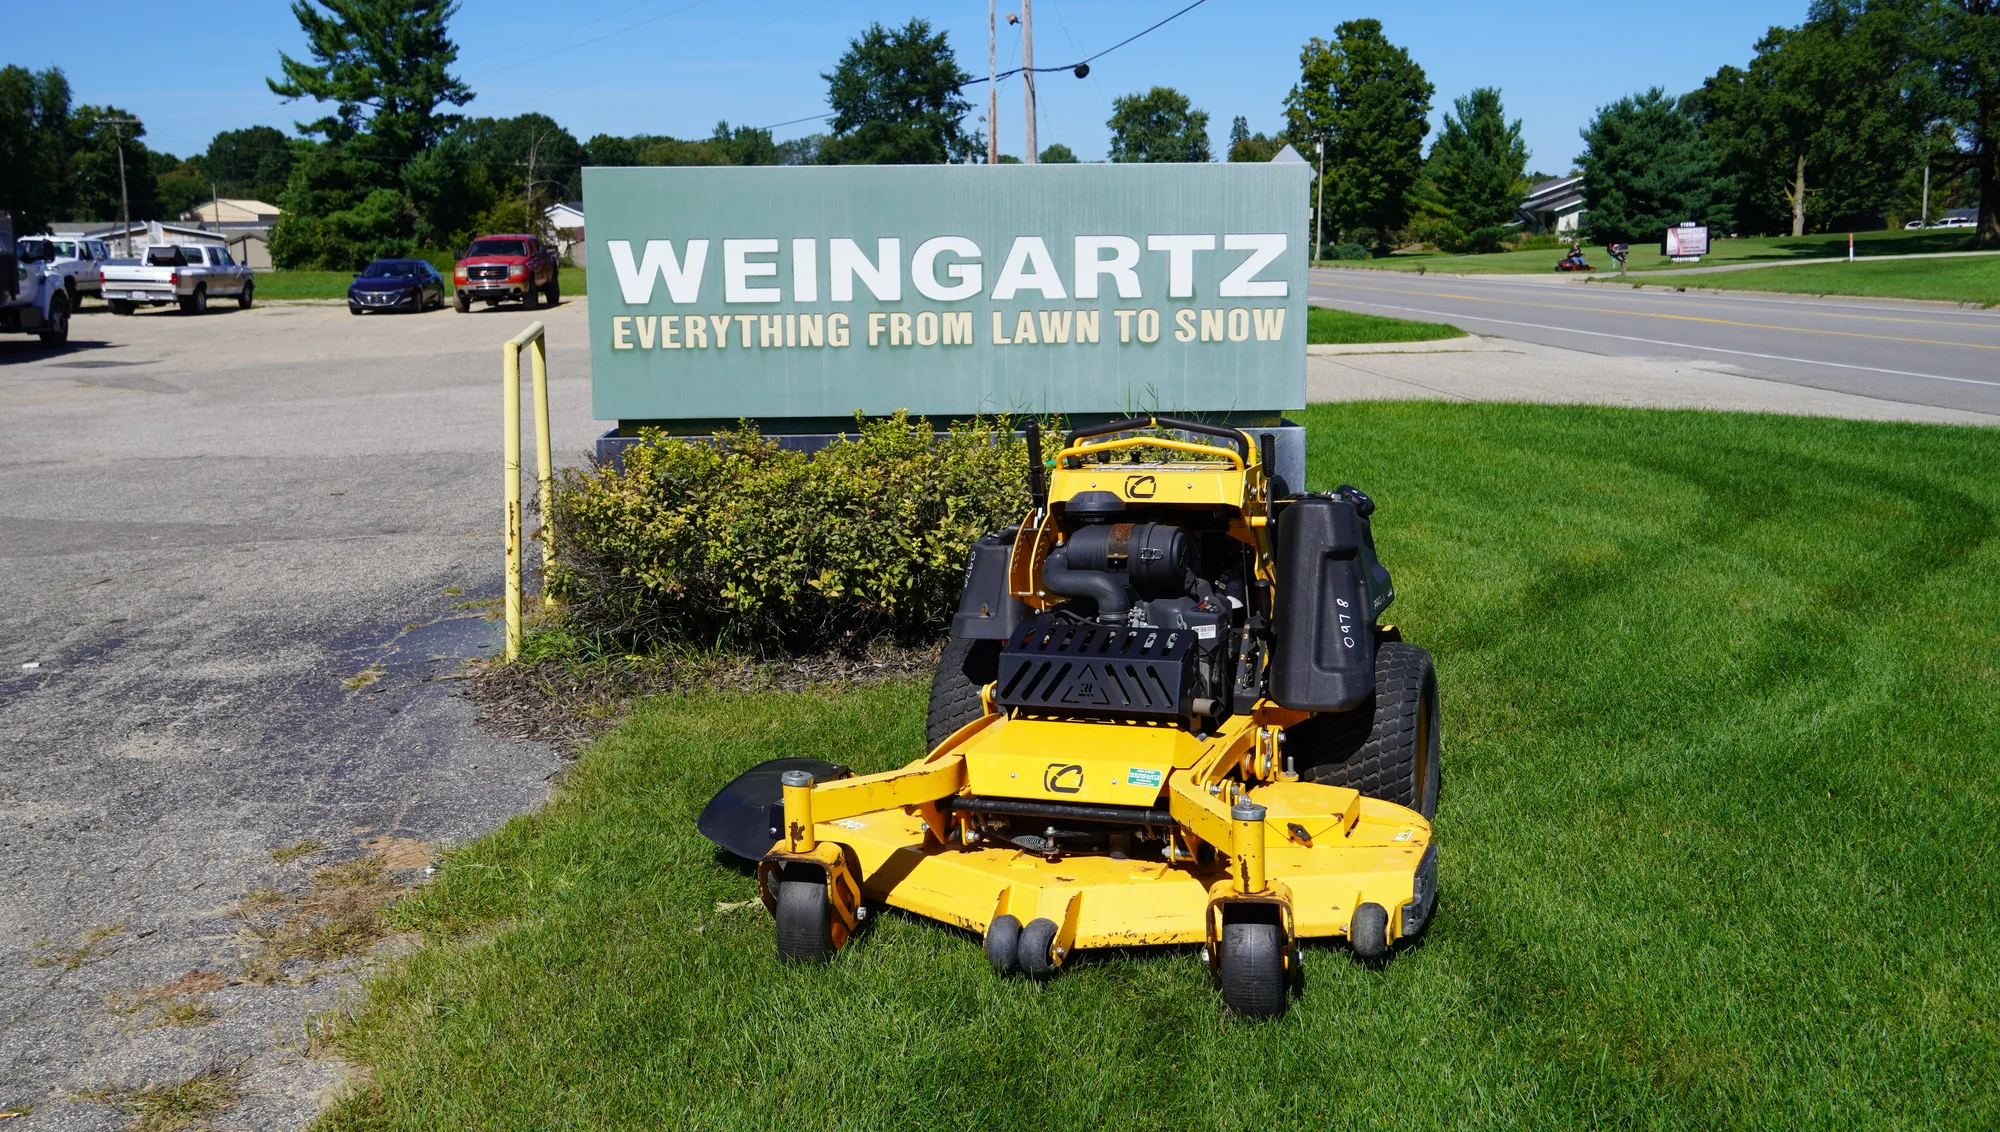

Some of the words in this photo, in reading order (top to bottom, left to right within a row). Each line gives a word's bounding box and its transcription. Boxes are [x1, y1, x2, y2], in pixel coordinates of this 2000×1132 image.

[607, 233, 1289, 304] WEINGARTZ
[612, 313, 851, 349] EVERYTHING
[868, 311, 974, 346] FROM
[992, 310, 1100, 344] LAWN
[1113, 309, 1161, 343] TO
[1175, 308, 1287, 342] SNOW
[1336, 598, 1355, 648] 0978
